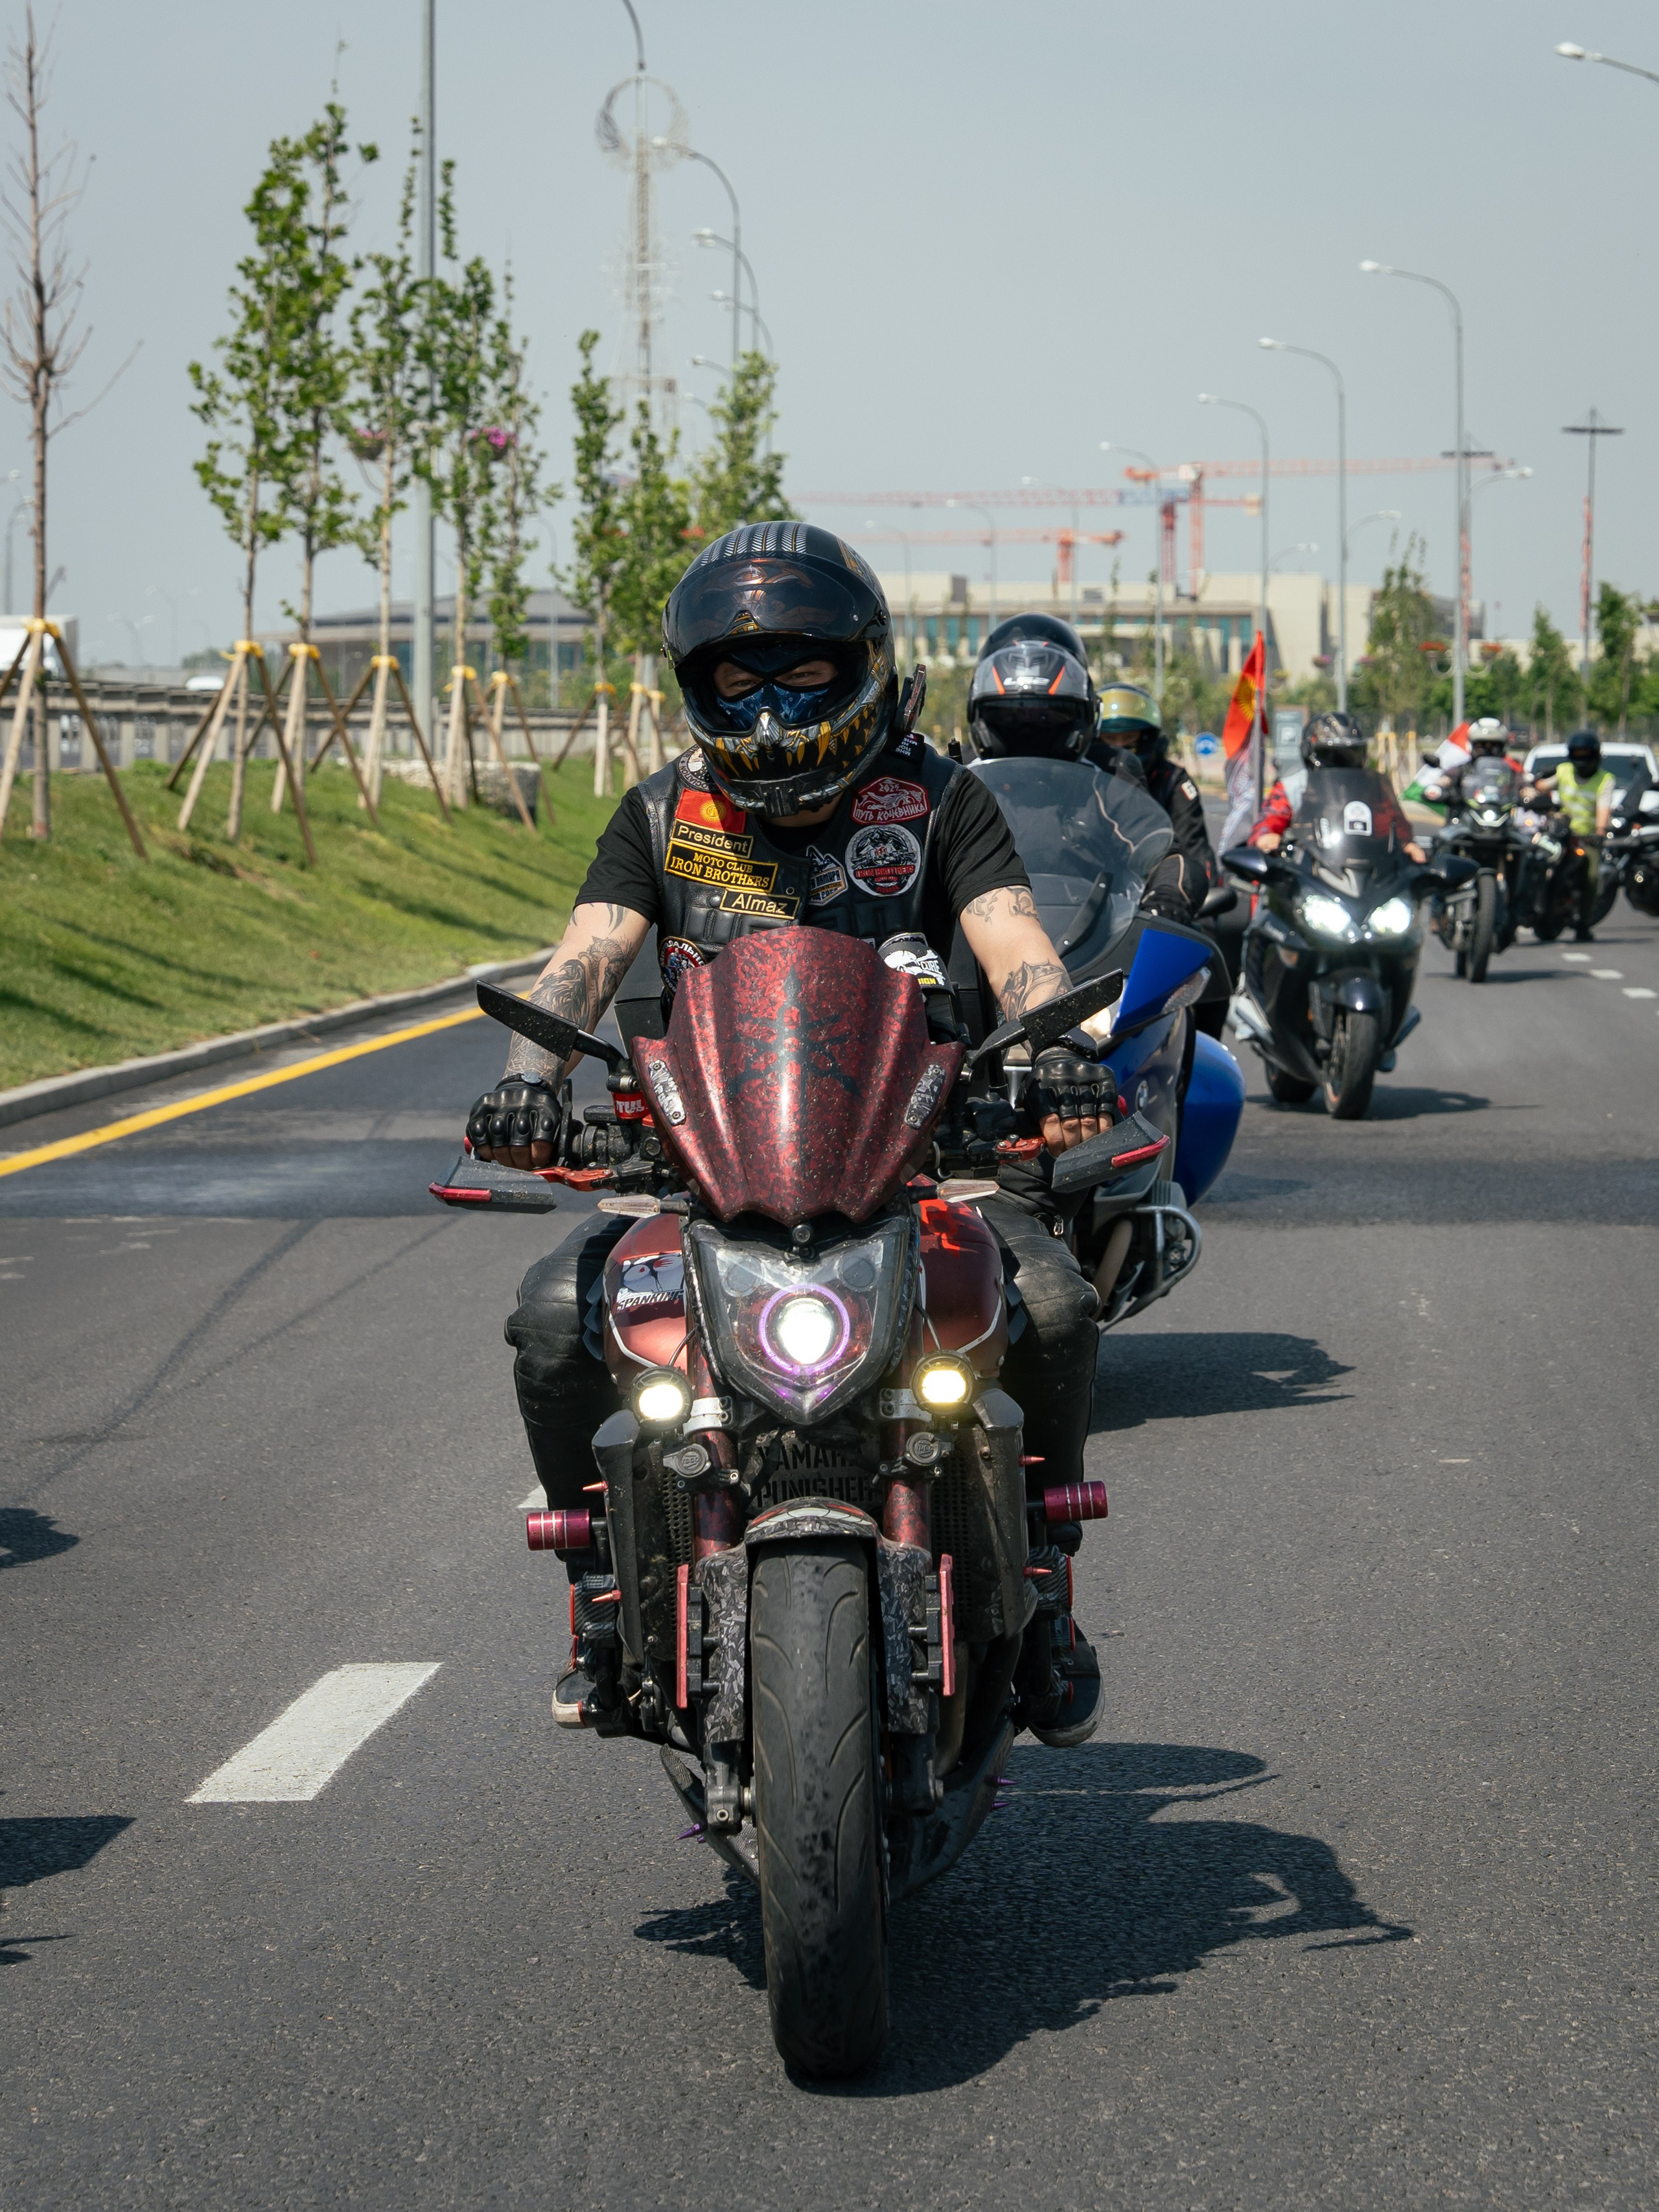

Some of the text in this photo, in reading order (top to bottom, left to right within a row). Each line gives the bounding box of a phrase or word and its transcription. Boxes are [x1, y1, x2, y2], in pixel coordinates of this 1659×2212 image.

[679, 765, 708, 788] OCIATION
[856, 804, 925, 821] ПУТЬ КОЧЕВНИКА
[678, 825, 748, 853] President
[670, 856, 770, 887] IRON BROTHERS
[693, 852, 753, 873] MOTO CLUB
[731, 893, 788, 914] Almaz
[616, 1099, 645, 1113] TUL
